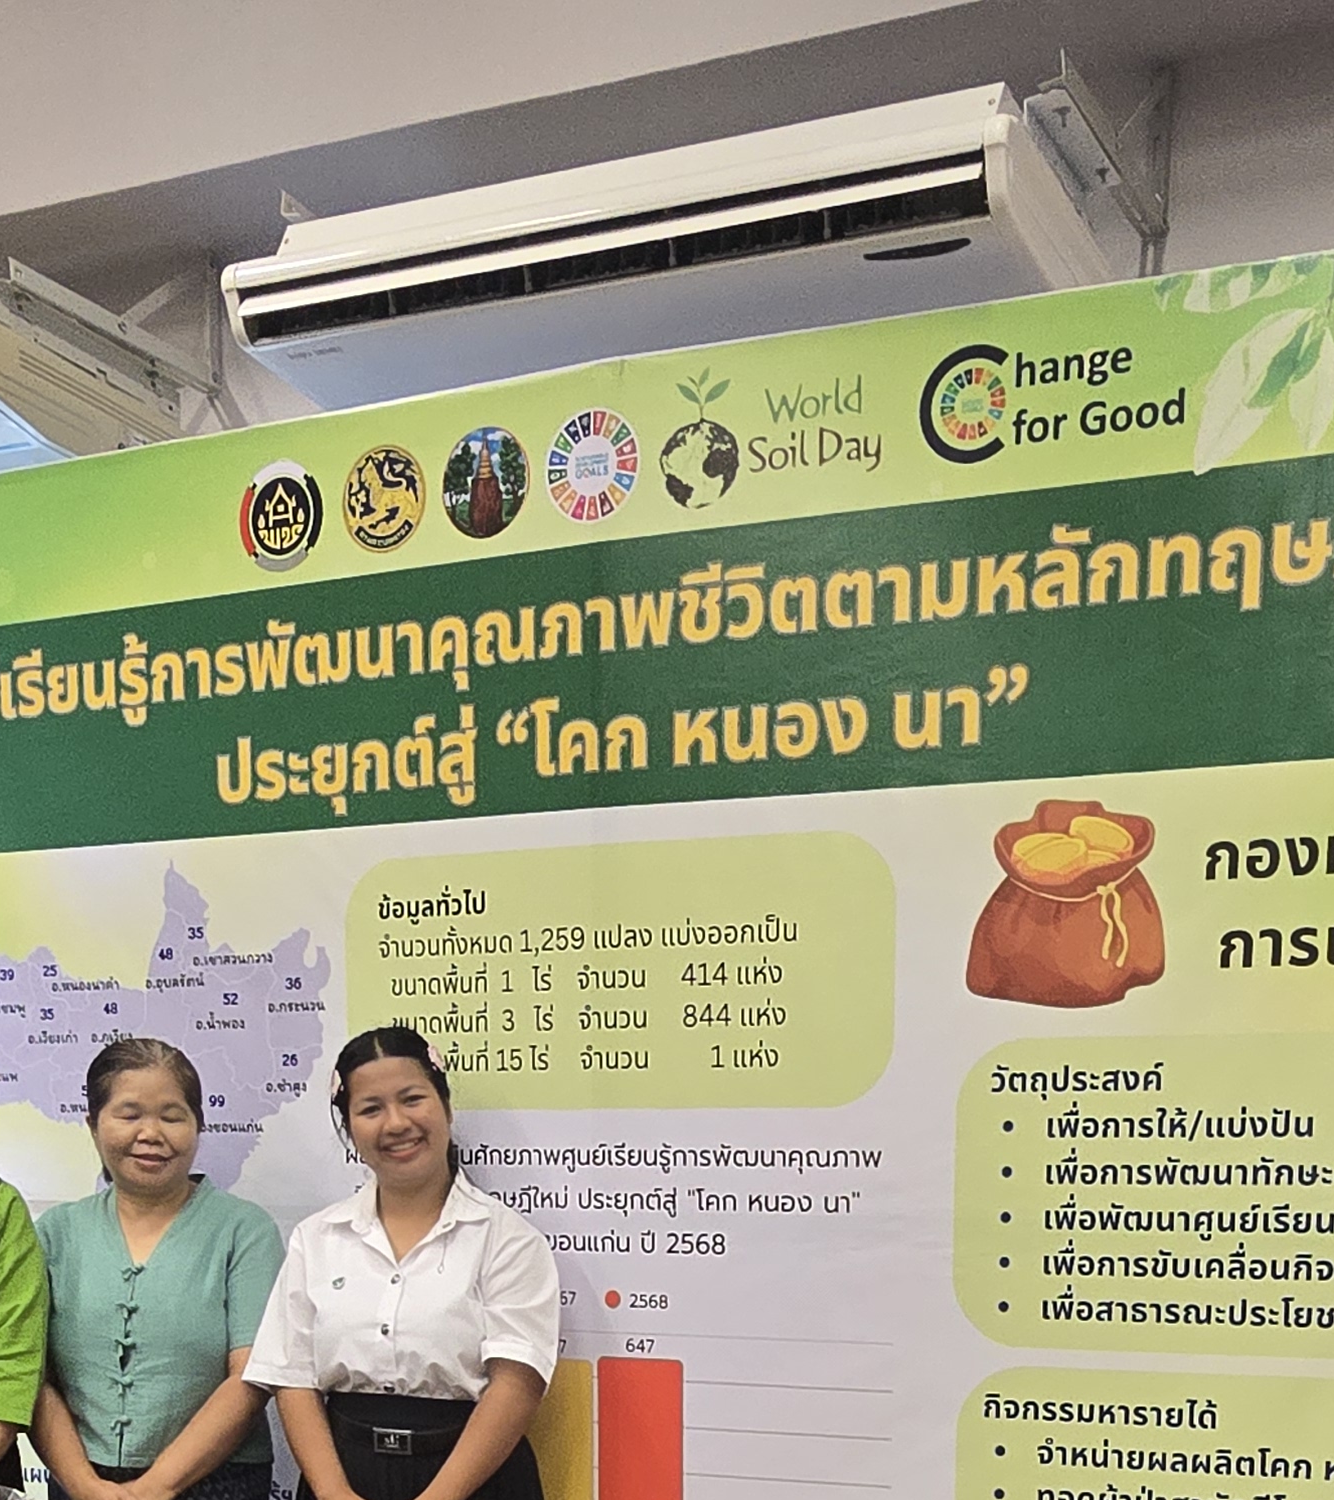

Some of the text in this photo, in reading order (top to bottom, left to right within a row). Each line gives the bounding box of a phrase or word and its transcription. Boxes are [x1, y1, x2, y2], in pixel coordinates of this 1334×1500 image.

[765, 375, 863, 423] World
[1012, 388, 1186, 445] for Good
[748, 427, 882, 473] Soil Day
[216, 706, 476, 816] ประยุกต์สู่
[673, 691, 866, 768] หนอง
[378, 887, 486, 927] ข้อมูลทั่วไป
[187, 926, 204, 940] 35
[379, 914, 799, 960] จำนวนทั้งหมด 1,259 แปลง แบ่งออกเป็น
[159, 948, 173, 960] 48
[193, 952, 273, 966] อ.เขาสวนกวาง
[0, 969, 14, 981] 39
[43, 965, 57, 977] 25
[391, 961, 783, 997] ขนาดพื้นที่ 1 ไร่ จำนวน 414 แห่ง
[146, 972, 204, 993] อ.อุบลรัตน์
[286, 978, 301, 989] 36
[104, 1003, 118, 1014] 48
[223, 993, 238, 1005] 52
[268, 1001, 325, 1012] อ.กระนวน
[40, 1009, 54, 1020] 35
[196, 1012, 245, 1029] อ.น้ำพอง
[502, 1010, 515, 1031] 3
[533, 1004, 554, 1031] ไร่
[578, 1005, 648, 1030] จำนวน
[682, 1003, 732, 1027] 844
[740, 998, 787, 1027] แห่ง
[283, 1055, 298, 1066] 26
[444, 1040, 780, 1073] พื้นที่ 15 ไร่ จำนวน 1 แห่ง
[990, 1062, 1164, 1099] วัตถุประสงค์
[209, 1096, 225, 1107] 99
[1045, 1102, 1315, 1140] เพื่อการให้/แบ่งปัน
[578, 1188, 678, 1216] ประยุกต์สู่
[747, 1193, 813, 1213] หนอง
[641, 1231, 656, 1254] ปี
[666, 1232, 726, 1255] 2568
[629, 1293, 668, 1310] 2568
[625, 1338, 655, 1354] 647
[983, 1392, 1217, 1431] กิจกรรมหารายได้
[1037, 1438, 1313, 1481] จำหน่ายผลผลิตโคก
